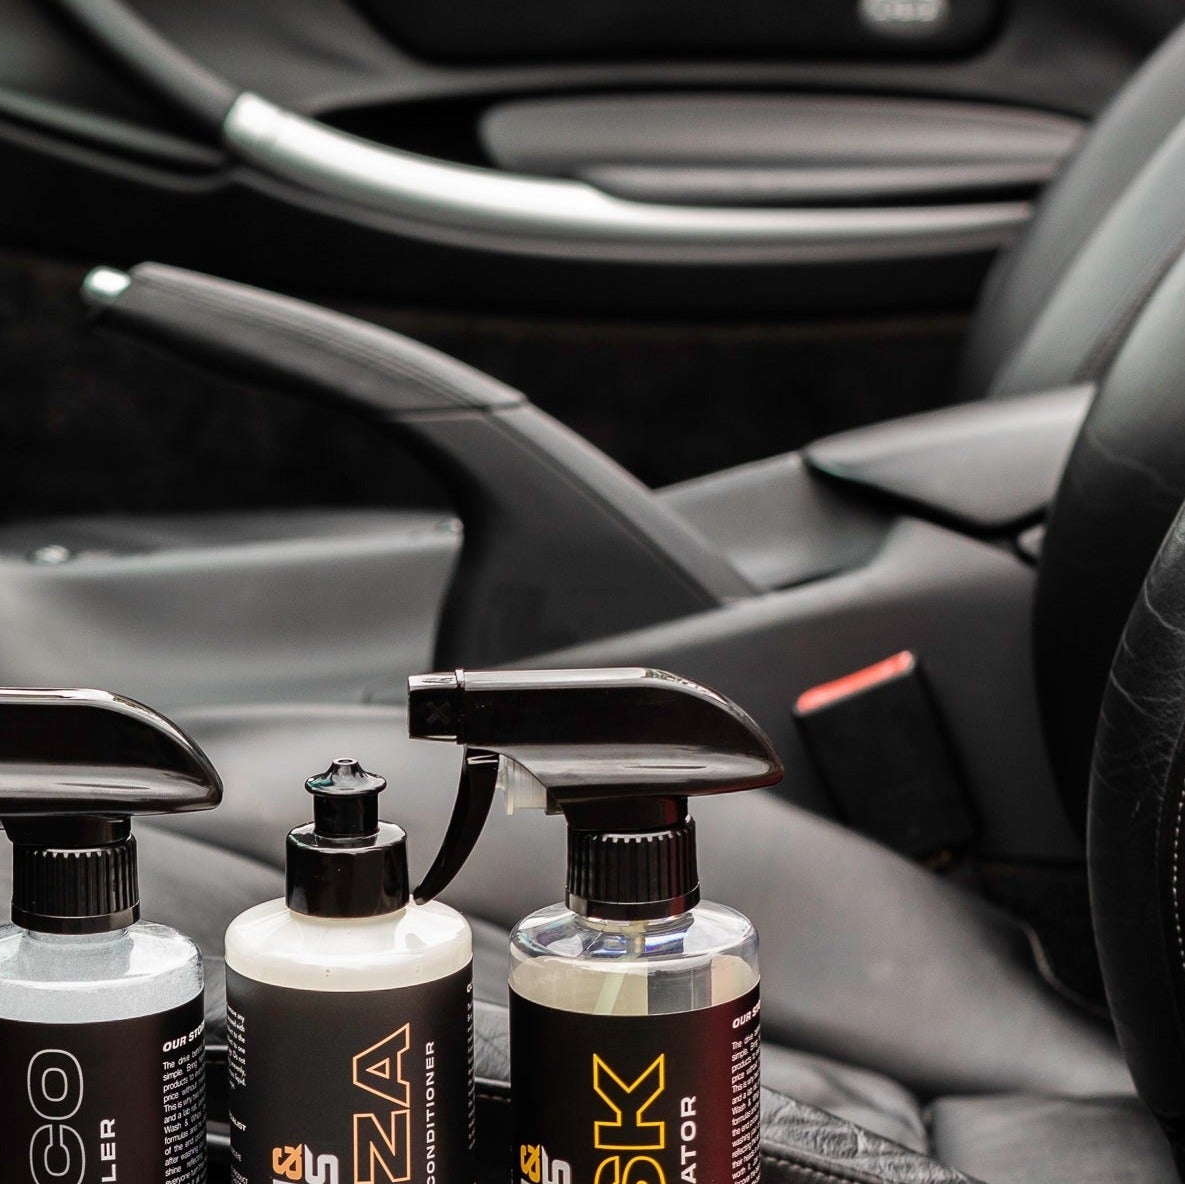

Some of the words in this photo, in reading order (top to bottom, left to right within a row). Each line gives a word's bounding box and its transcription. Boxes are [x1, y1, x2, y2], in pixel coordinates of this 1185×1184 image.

[732, 1011, 751, 1028] OUR
[163, 1036, 186, 1051] OUR
[164, 1122, 181, 1133] Wash
